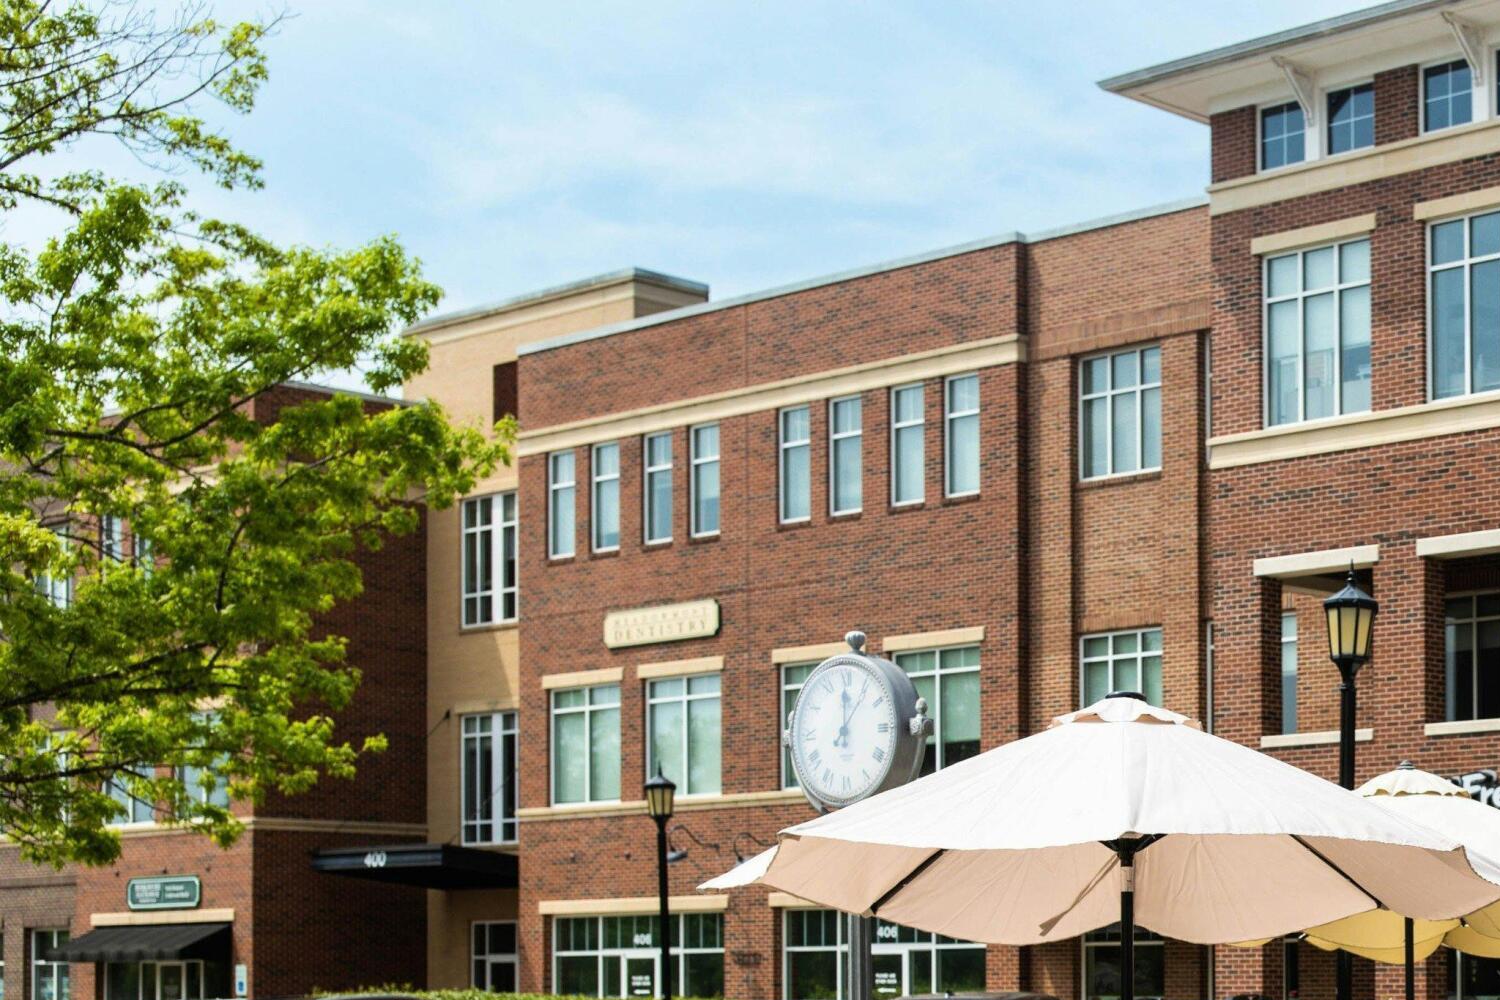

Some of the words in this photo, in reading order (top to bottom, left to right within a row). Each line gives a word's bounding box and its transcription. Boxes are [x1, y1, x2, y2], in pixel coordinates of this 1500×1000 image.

[613, 619, 706, 642] DENTISTRY
[363, 852, 388, 868] 400
[876, 925, 899, 939] 406
